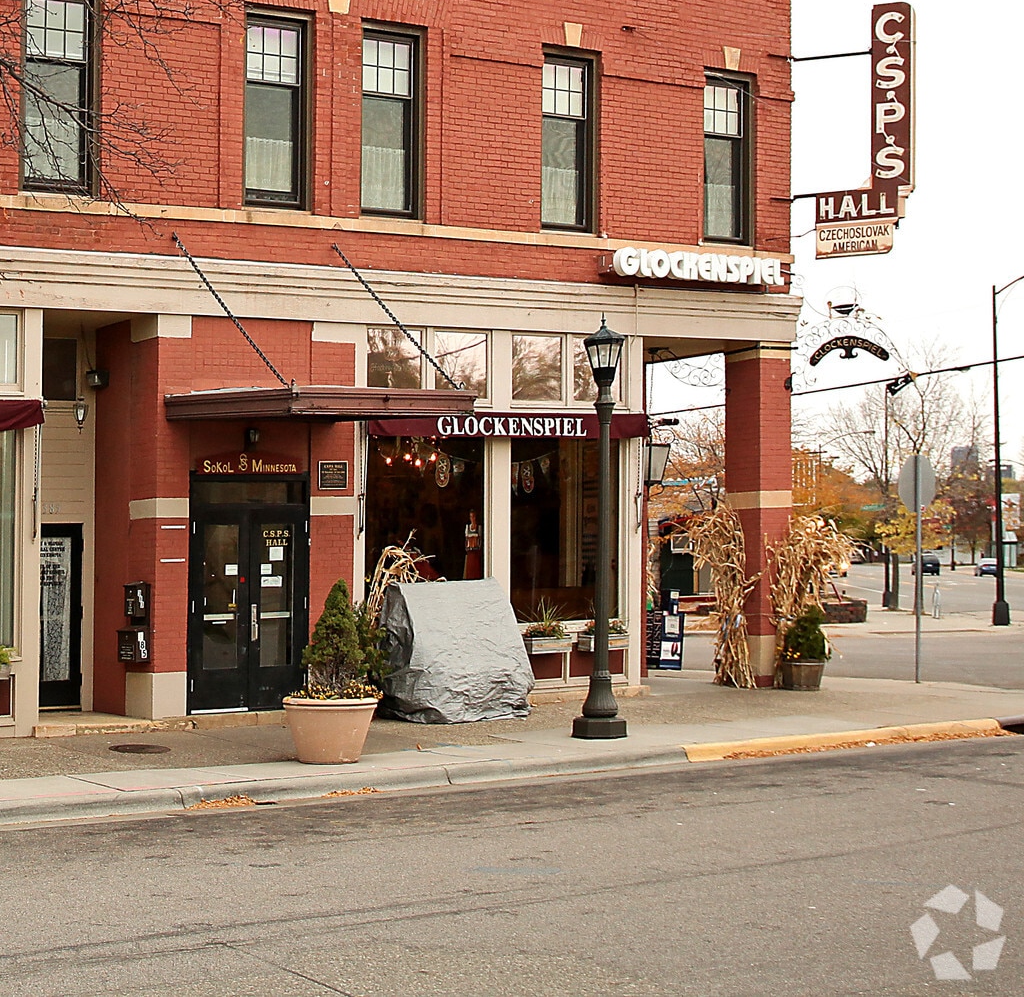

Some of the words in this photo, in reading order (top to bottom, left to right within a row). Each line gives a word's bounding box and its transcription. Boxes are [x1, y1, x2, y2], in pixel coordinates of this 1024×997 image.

[819, 192, 895, 220] HALL
[819, 225, 890, 242] CZECHOSLOVAK
[832, 239, 878, 252] AMERICAN
[614, 246, 785, 286] GLOCKENSPIEL
[436, 415, 587, 437] GLOCKENSPIEL
[265, 538, 289, 546] HALL
